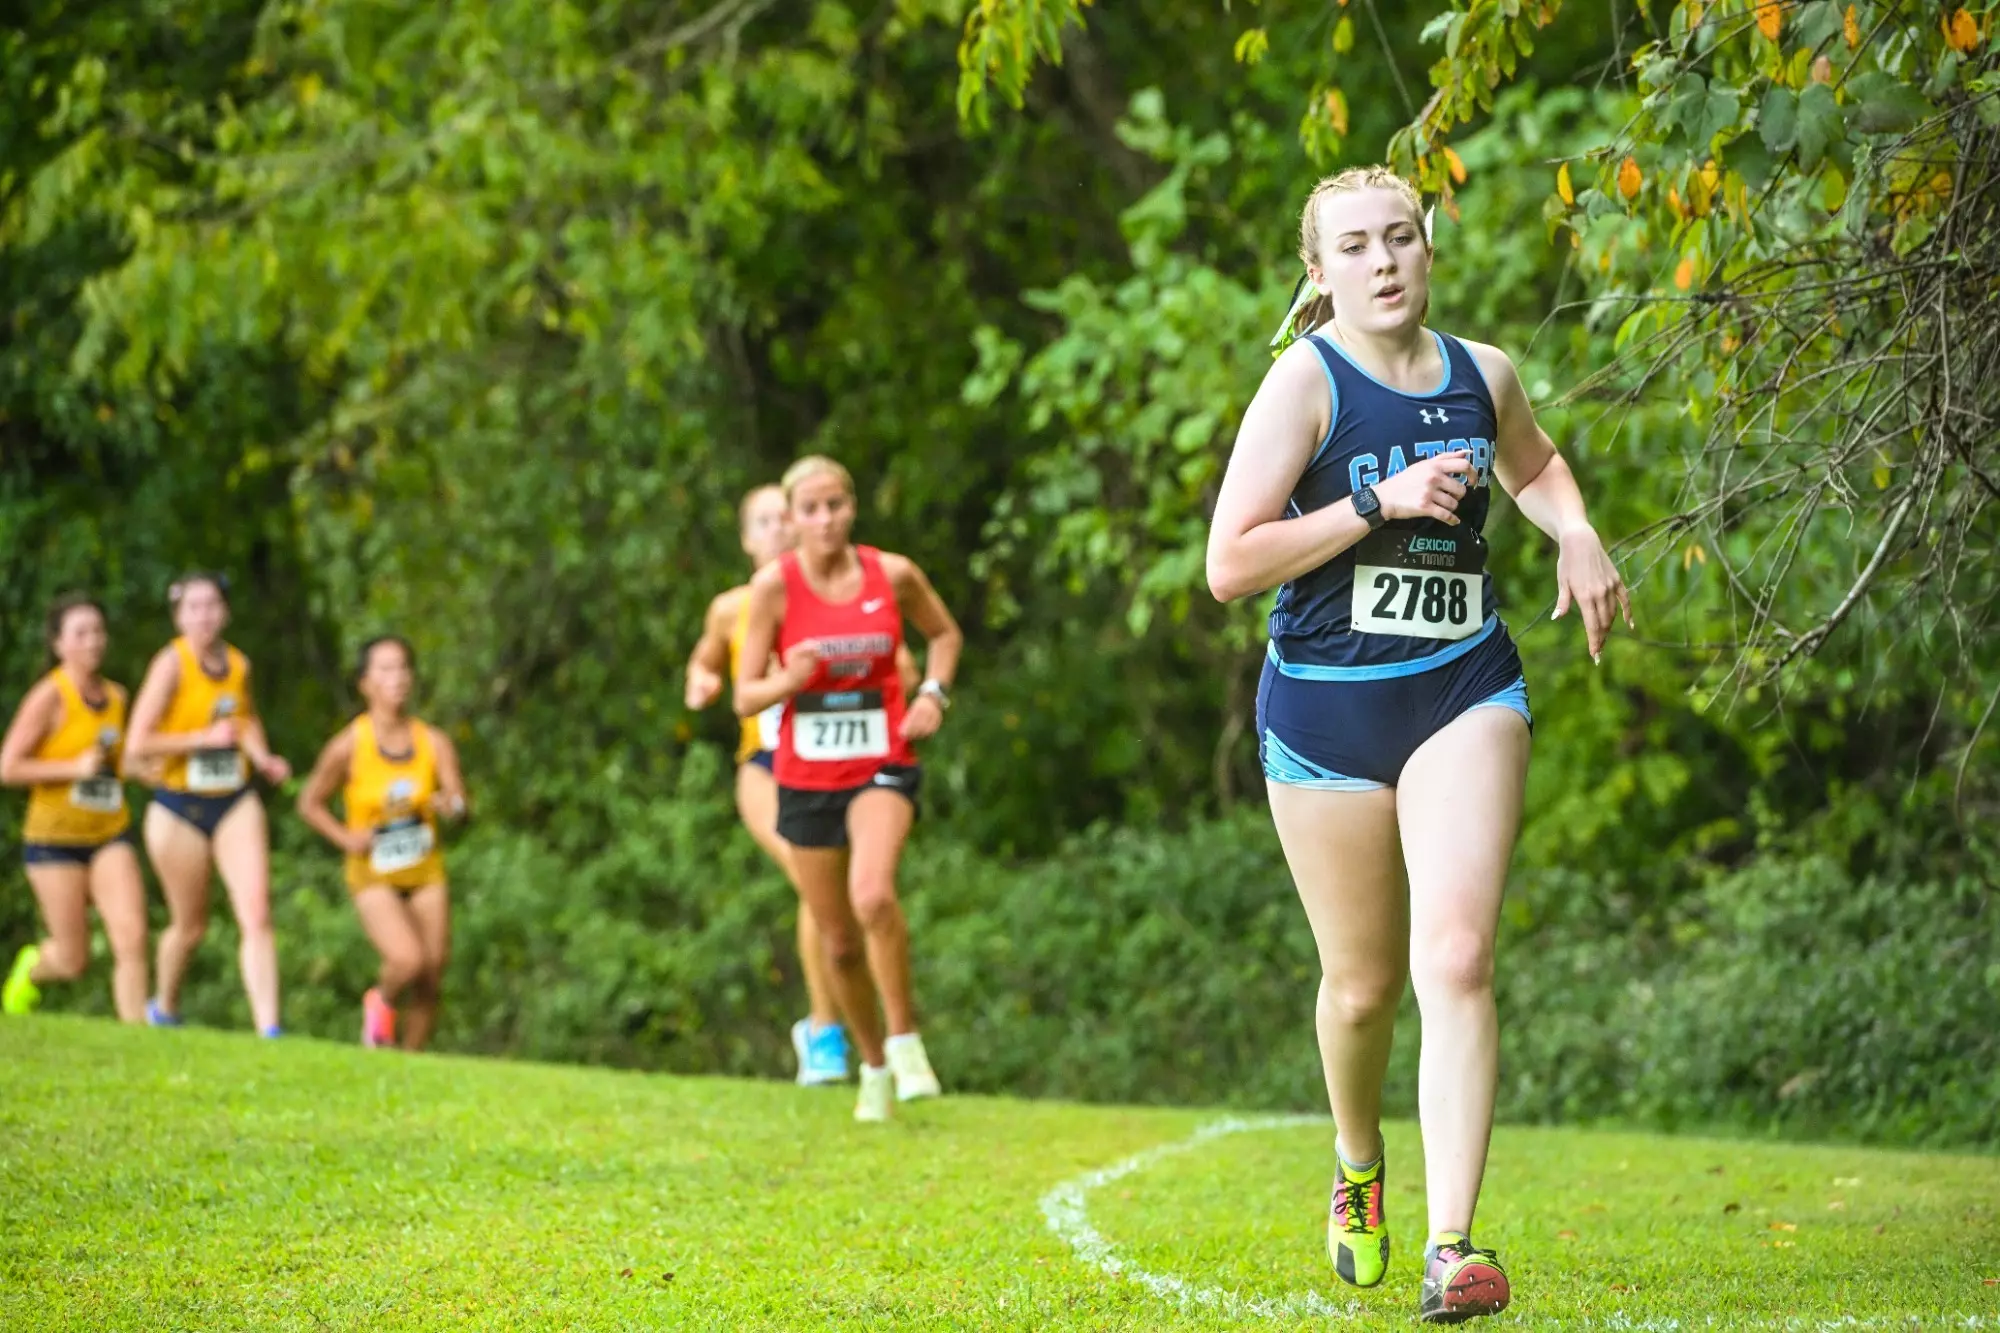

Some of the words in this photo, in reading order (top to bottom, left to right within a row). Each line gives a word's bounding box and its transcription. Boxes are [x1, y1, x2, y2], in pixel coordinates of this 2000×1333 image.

[1408, 535, 1456, 552] LEXICON
[1371, 572, 1468, 625] 2788
[813, 718, 869, 746] 2771
